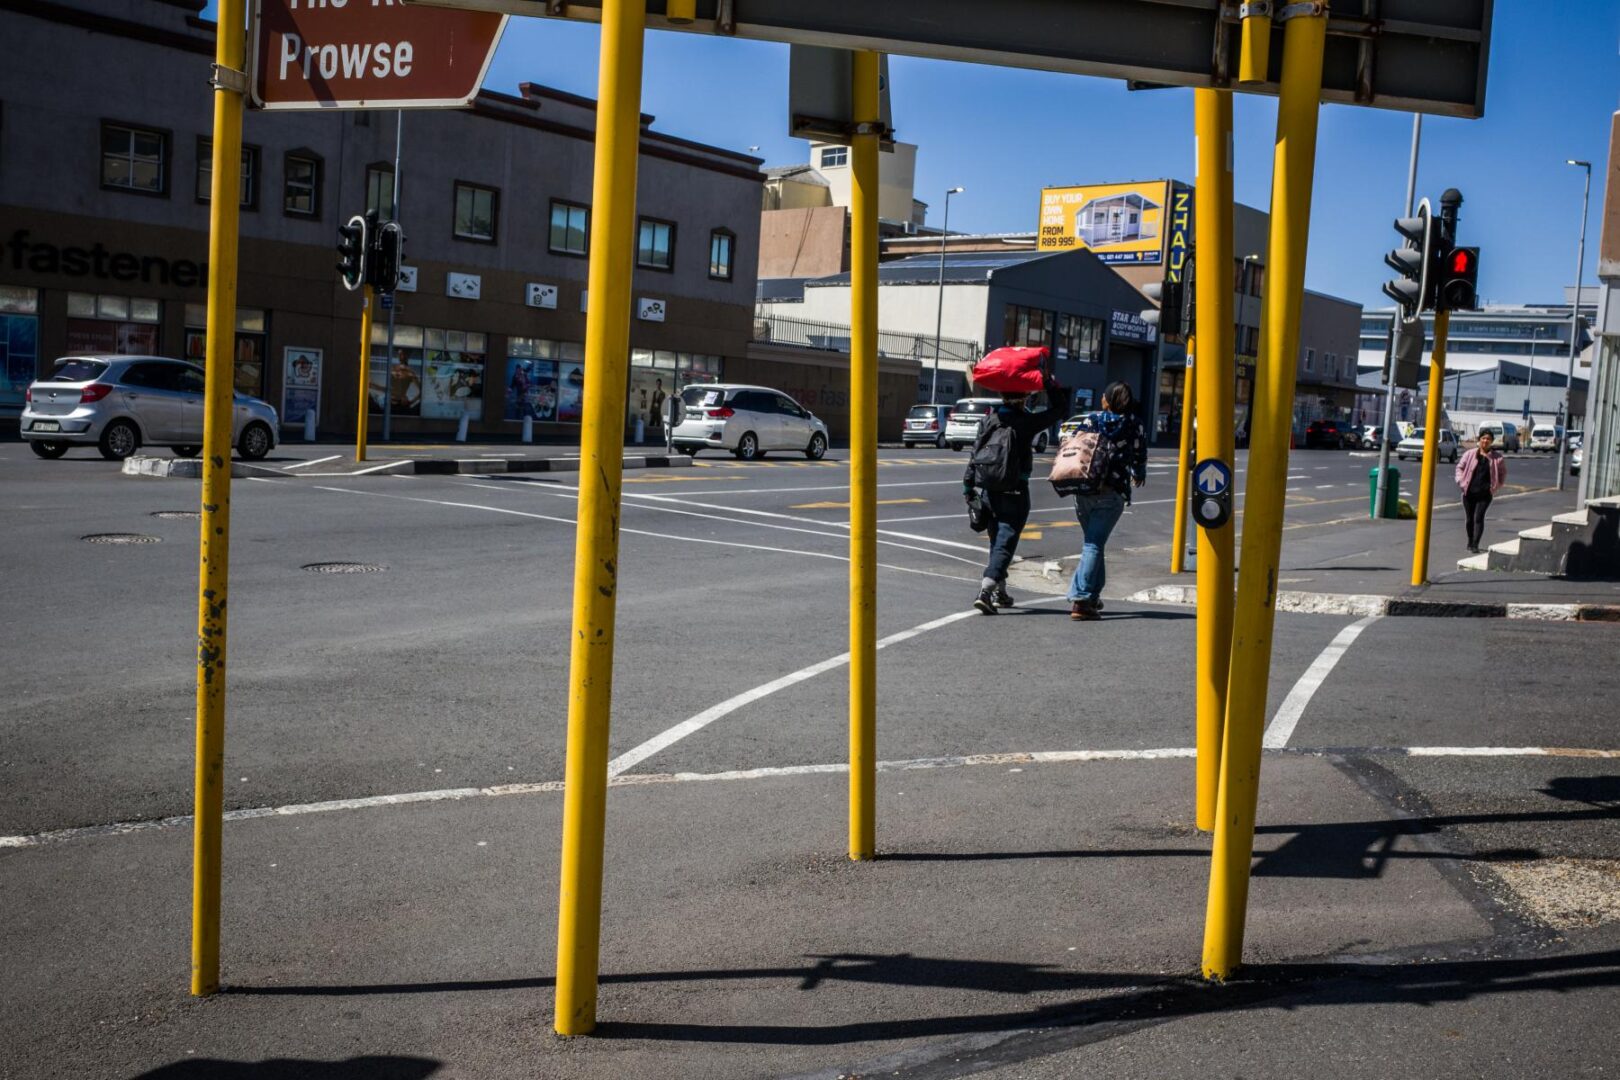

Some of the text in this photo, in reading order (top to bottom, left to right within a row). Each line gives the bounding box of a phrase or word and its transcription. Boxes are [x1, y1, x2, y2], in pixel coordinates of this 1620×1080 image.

[279, 32, 414, 80] Prowse
[1044, 192, 1083, 204] BUY YOUR
[1043, 205, 1063, 215] OWN
[1043, 215, 1065, 225] HOME
[1042, 226, 1063, 235] FROM
[1041, 236, 1076, 247] R89 995!
[1112, 311, 1130, 323] STAR
[1112, 322, 1146, 333] BODYWORKS
